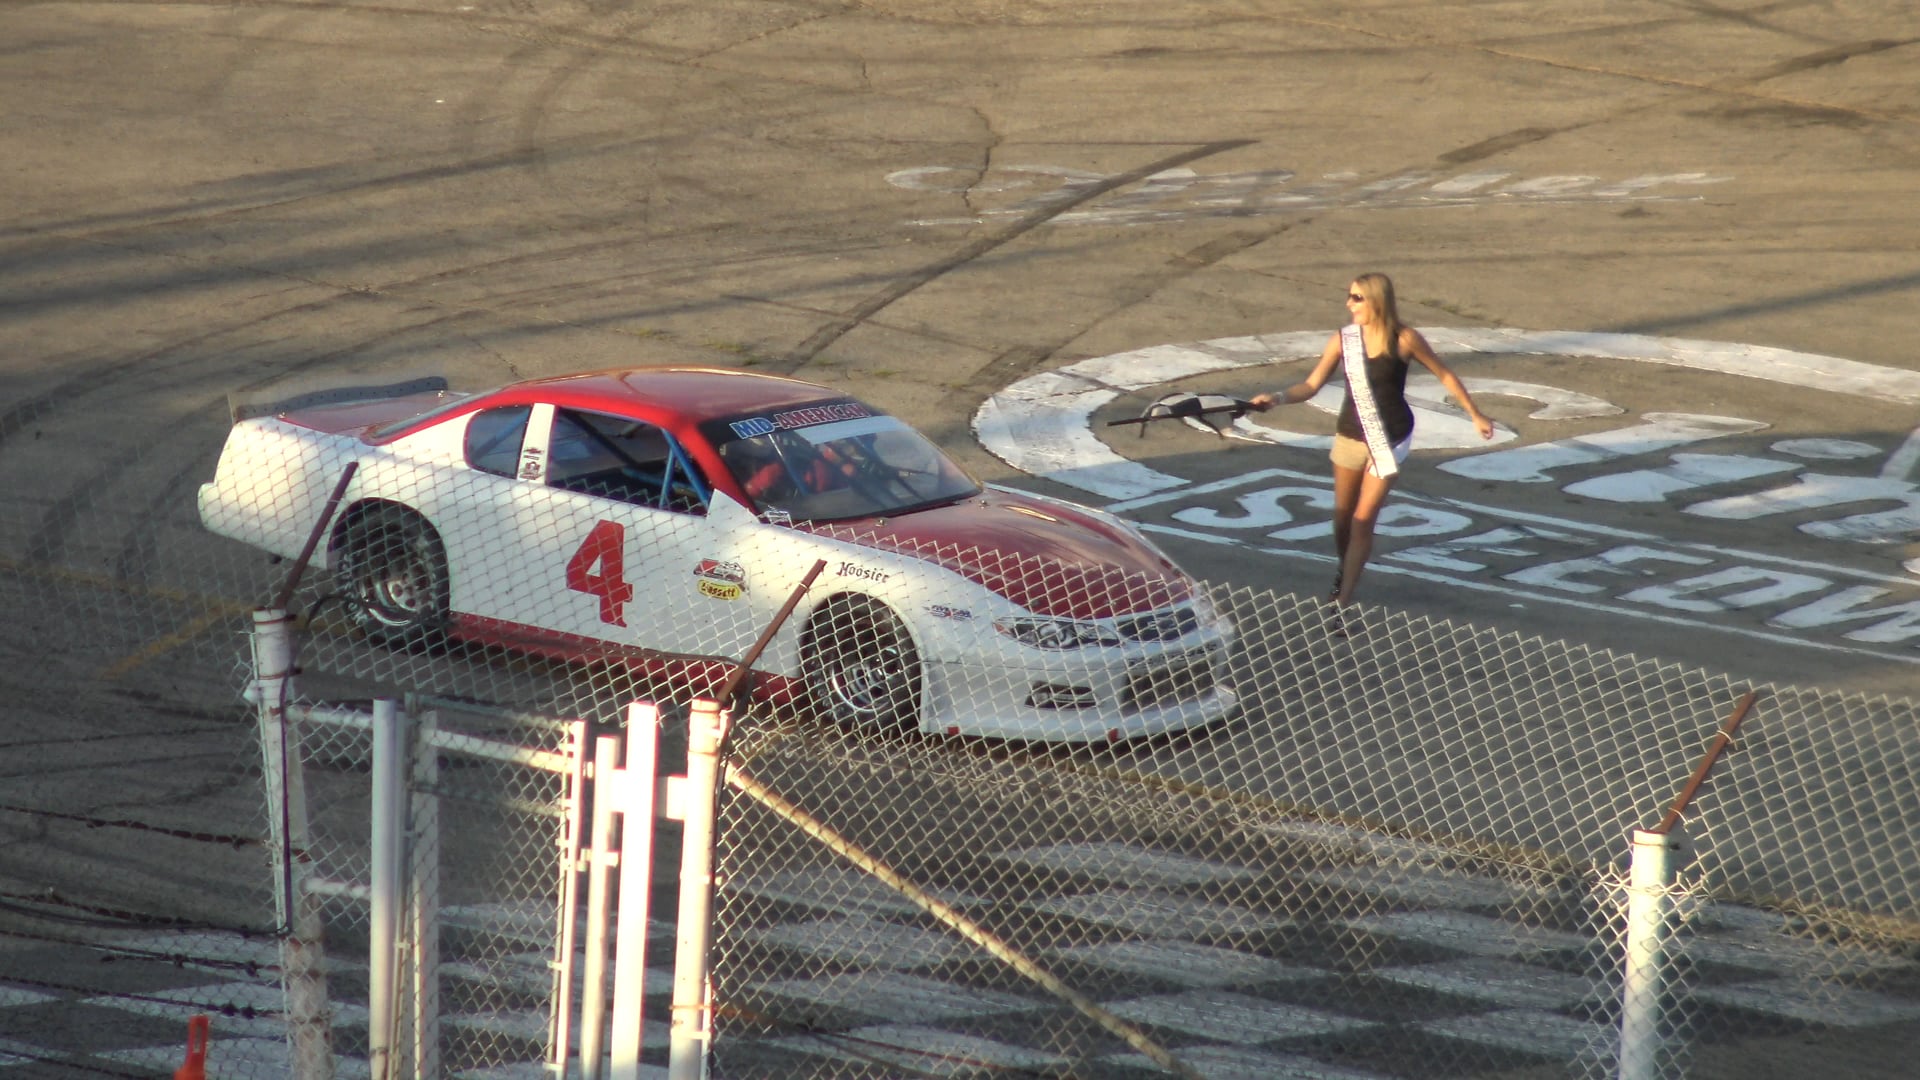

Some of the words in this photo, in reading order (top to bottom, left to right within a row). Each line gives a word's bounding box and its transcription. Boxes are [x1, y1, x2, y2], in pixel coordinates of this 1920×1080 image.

[729, 403, 872, 439] MID-AMERICAN
[566, 519, 634, 628] 4
[836, 561, 889, 583] Hoosier
